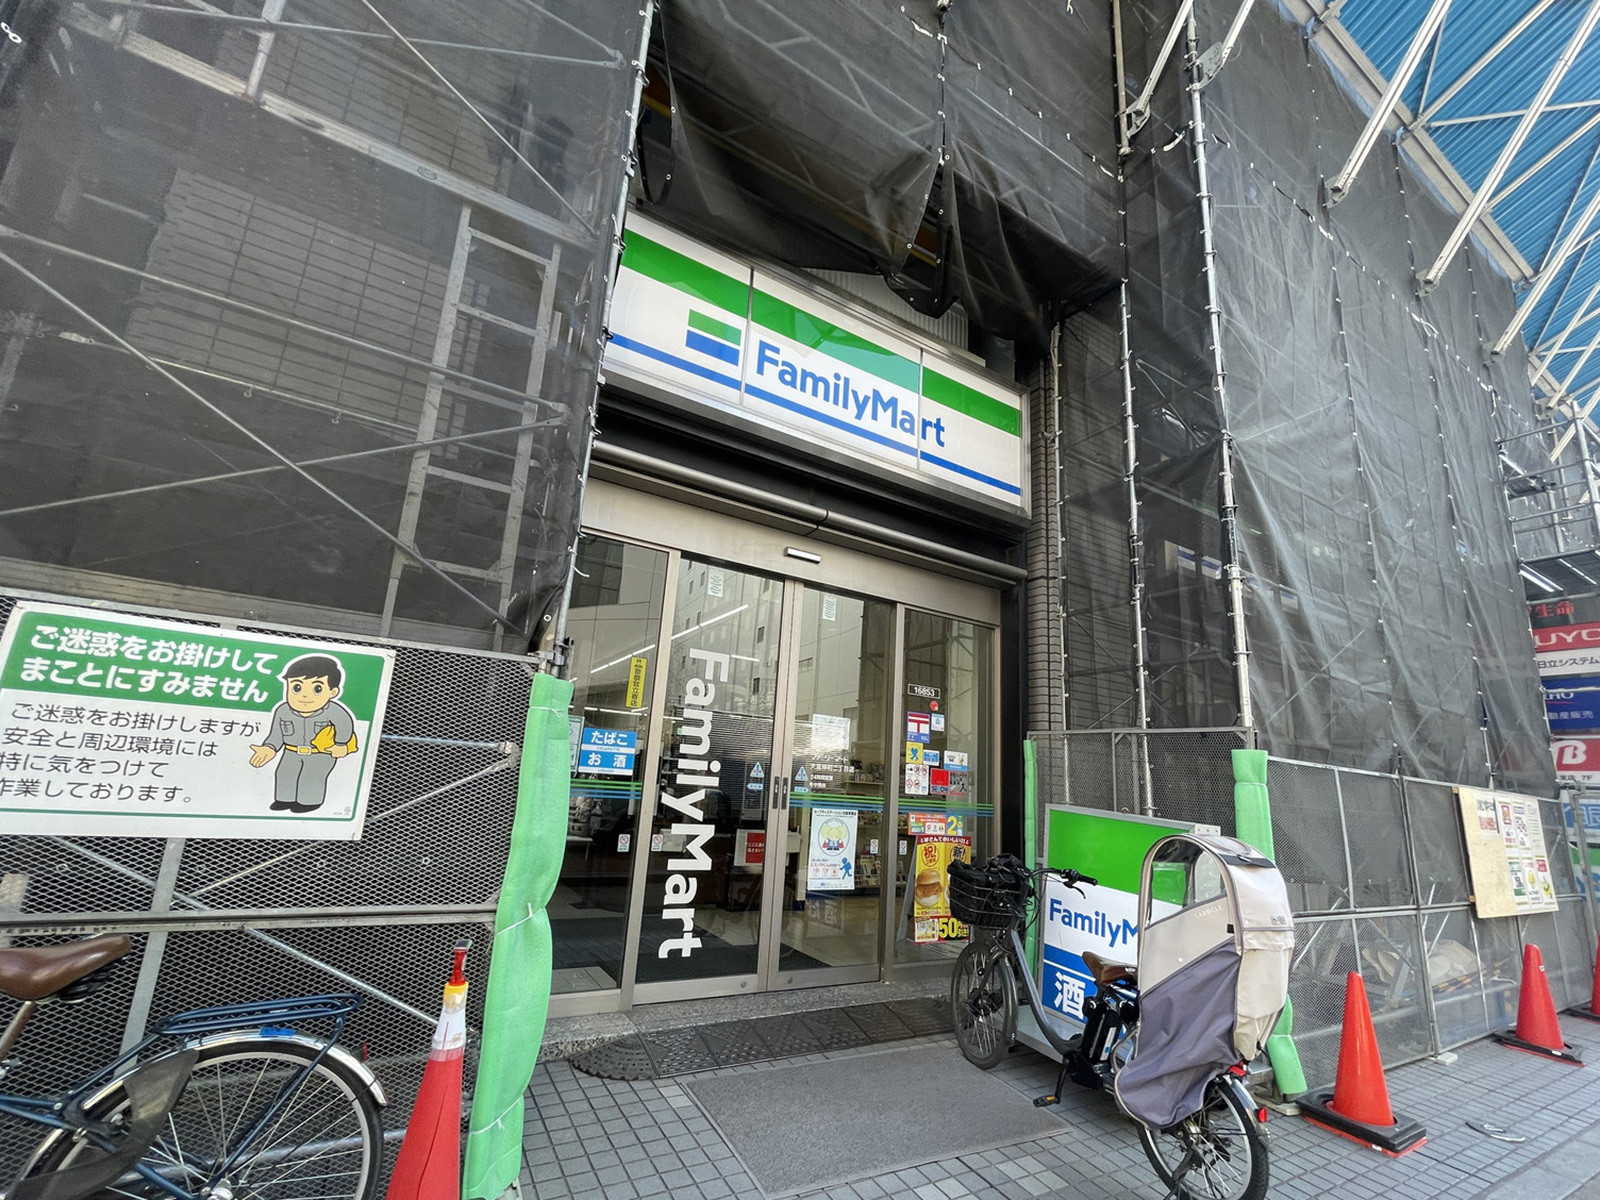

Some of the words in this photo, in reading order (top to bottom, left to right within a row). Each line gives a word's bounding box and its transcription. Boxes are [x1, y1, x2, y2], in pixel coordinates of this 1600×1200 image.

[756, 339, 945, 448] FamilyMart
[30, 625, 278, 674] ご迷惑をお掛けして
[20, 657, 269, 704] まことにすみません
[914, 687, 935, 697] 16853
[2, 727, 219, 757] 安全と周辺環境には
[11, 703, 262, 738] ご迷惑をお掛けしますが
[590, 730, 628, 746] たばこ
[658, 648, 730, 959] FamilyMart
[1053, 971, 1086, 1020] 酒
